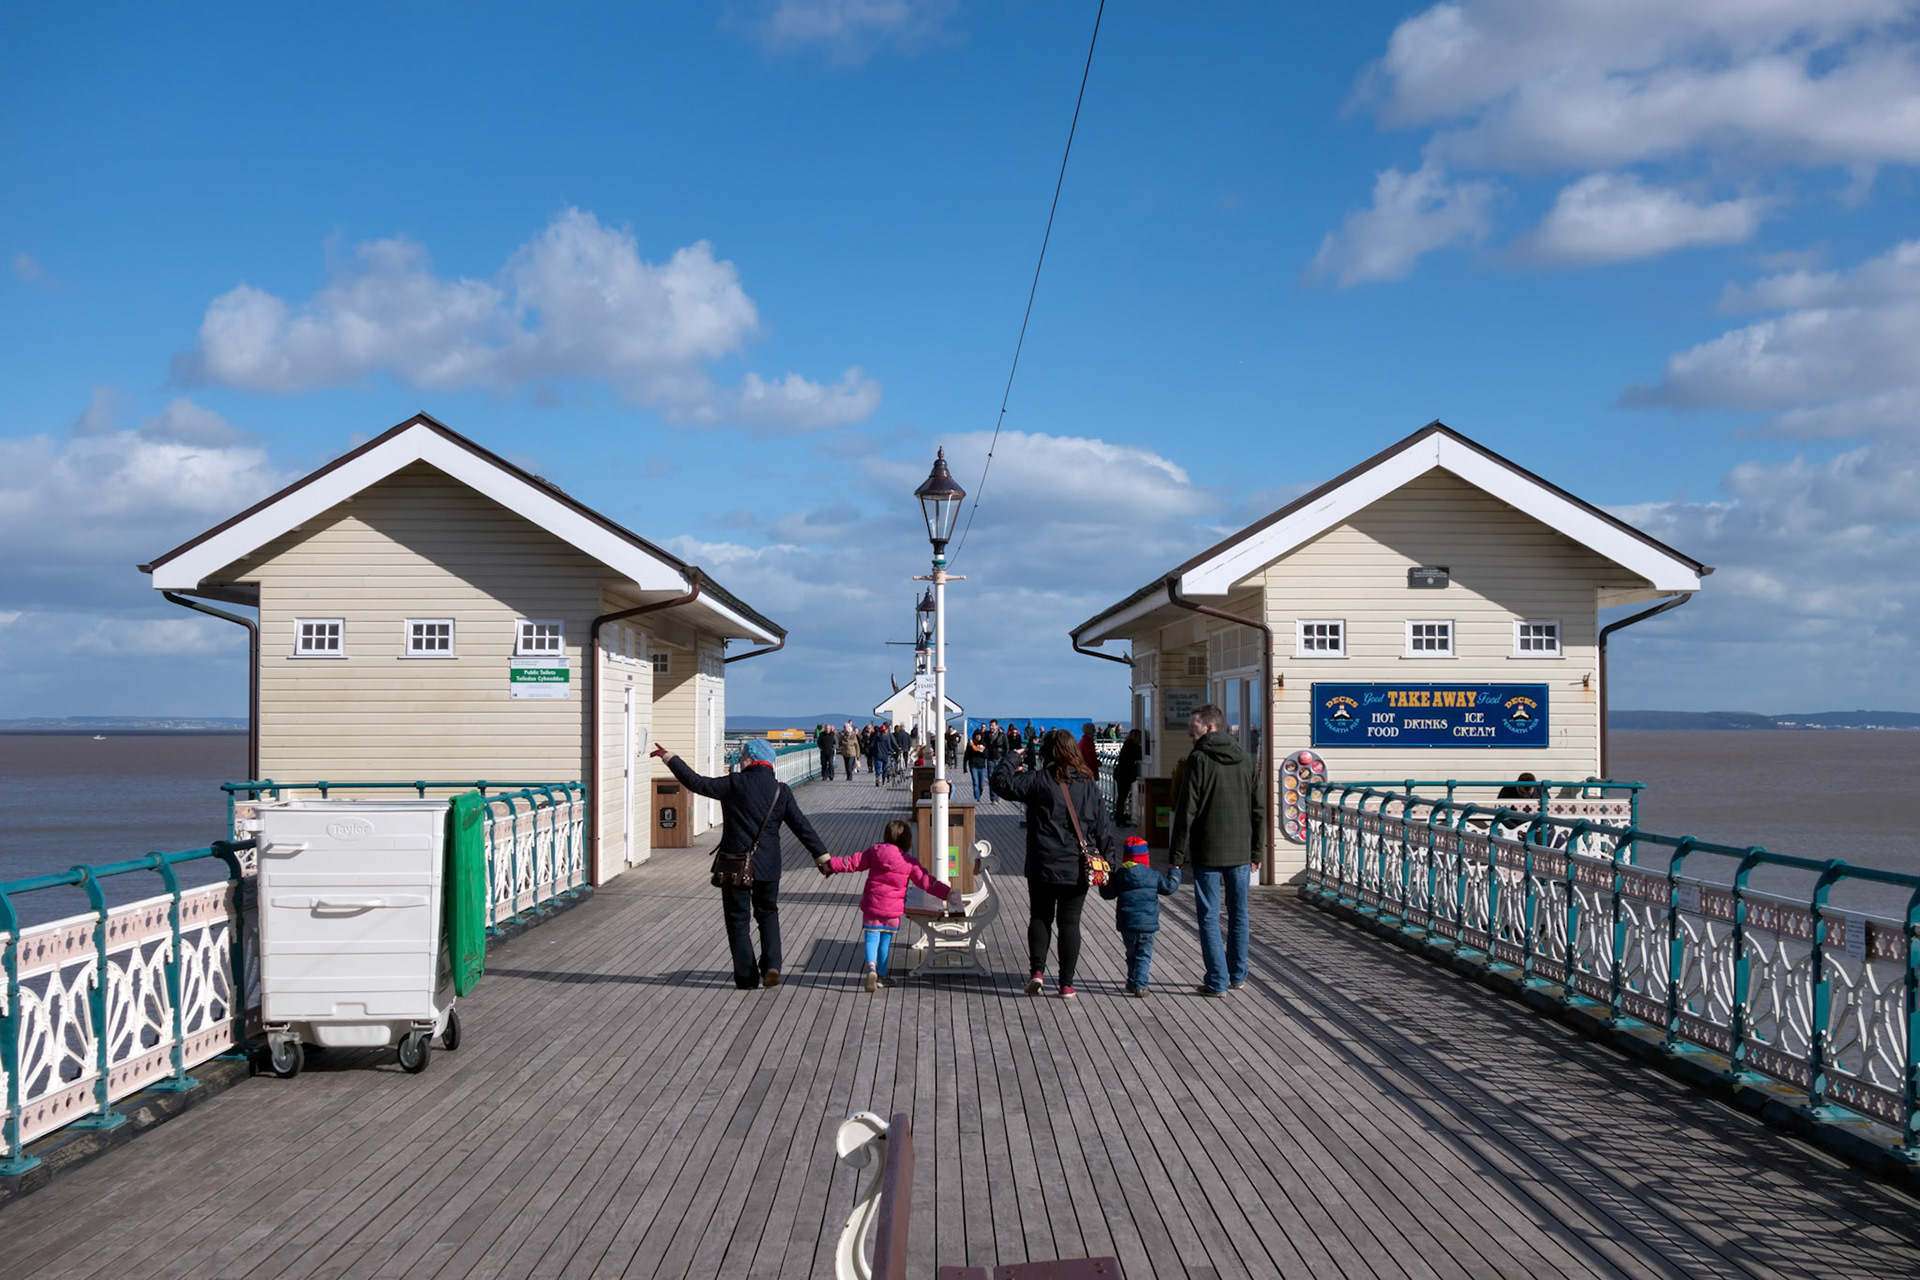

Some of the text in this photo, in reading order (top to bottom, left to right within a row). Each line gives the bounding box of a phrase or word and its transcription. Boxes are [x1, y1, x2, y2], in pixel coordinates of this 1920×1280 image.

[1325, 696, 1359, 709] DECKS
[1362, 692, 1385, 706] Good
[1476, 692, 1503, 705] Food
[1504, 696, 1538, 709] DECKS
[1371, 712, 1396, 723] HOT
[1403, 718, 1448, 730] DRINKS
[1464, 712, 1485, 723] ICE
[1323, 717, 1361, 733] PENARTH PIER
[1367, 726, 1400, 737] FOOD
[1452, 726, 1496, 737] CREAM
[1502, 718, 1540, 734] PENARTH PIER
[332, 822, 368, 836] Taylor
